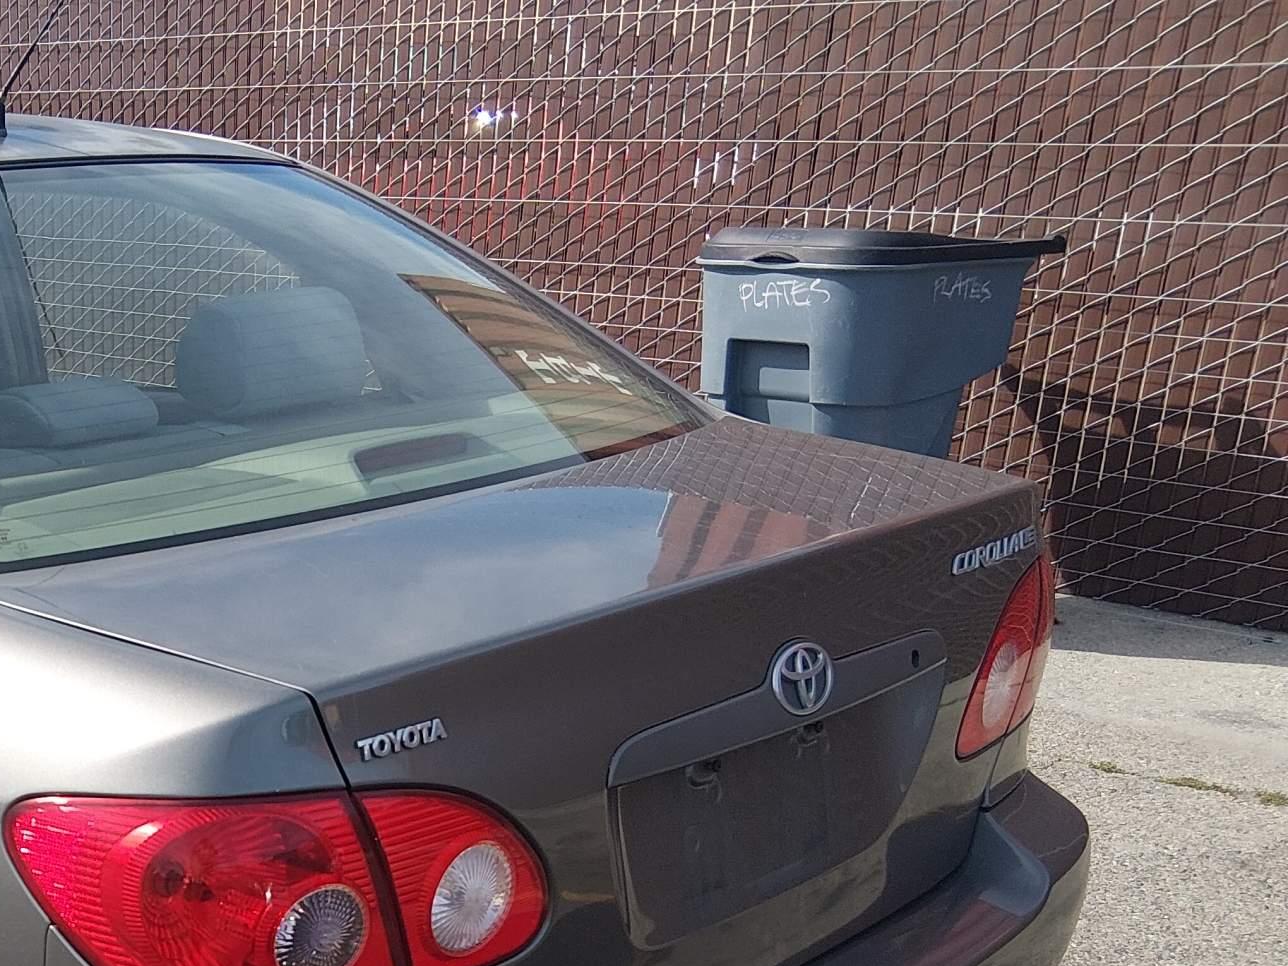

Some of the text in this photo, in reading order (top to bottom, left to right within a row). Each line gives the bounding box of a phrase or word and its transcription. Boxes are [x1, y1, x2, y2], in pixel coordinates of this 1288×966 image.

[739, 278, 831, 313] PLATES
[933, 271, 992, 304] PLATES
[951, 532, 1020, 576] COROLLA
[356, 718, 448, 761] TOYOTA
